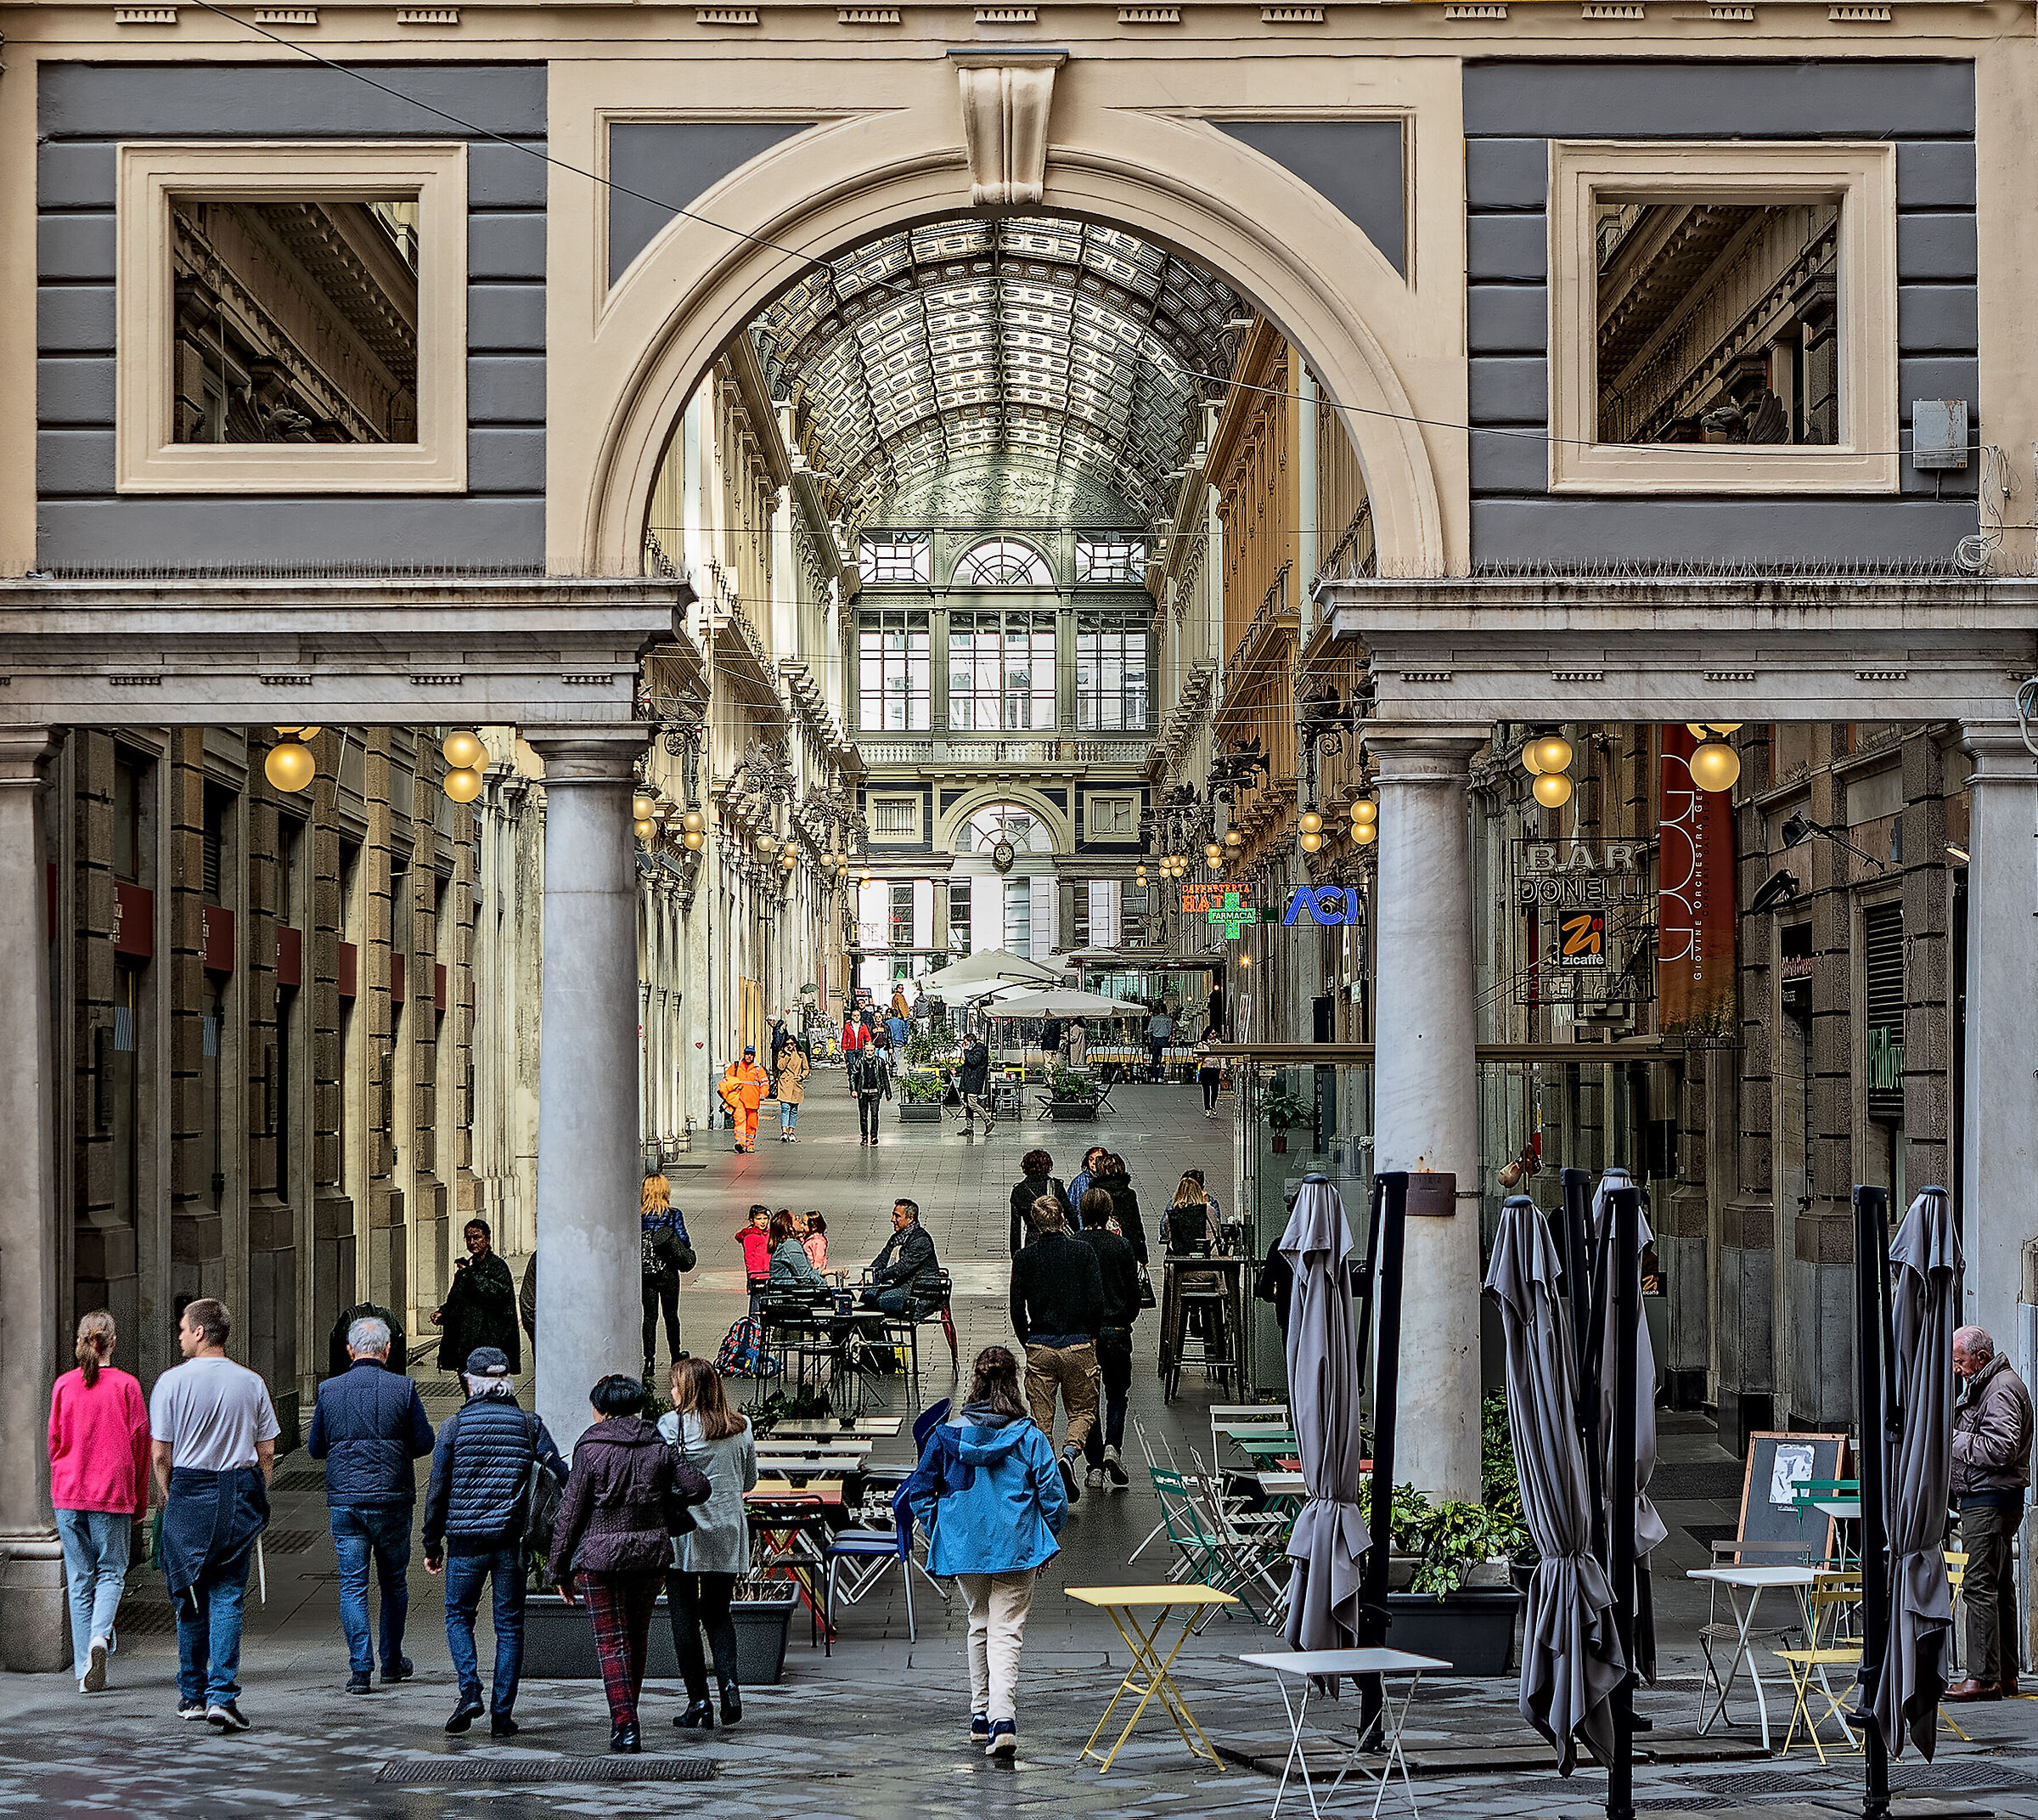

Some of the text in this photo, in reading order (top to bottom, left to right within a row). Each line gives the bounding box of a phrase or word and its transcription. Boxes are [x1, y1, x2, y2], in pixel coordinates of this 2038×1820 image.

[1528, 843, 1635, 871] BAR
[1693, 823, 1703, 909] ORCHESTRA
[1518, 877, 1644, 904] DONELLI
[1212, 911, 1253, 920] FARMACIA
[1283, 885, 1359, 926] ACI
[1562, 954, 1605, 966] zicaffè
